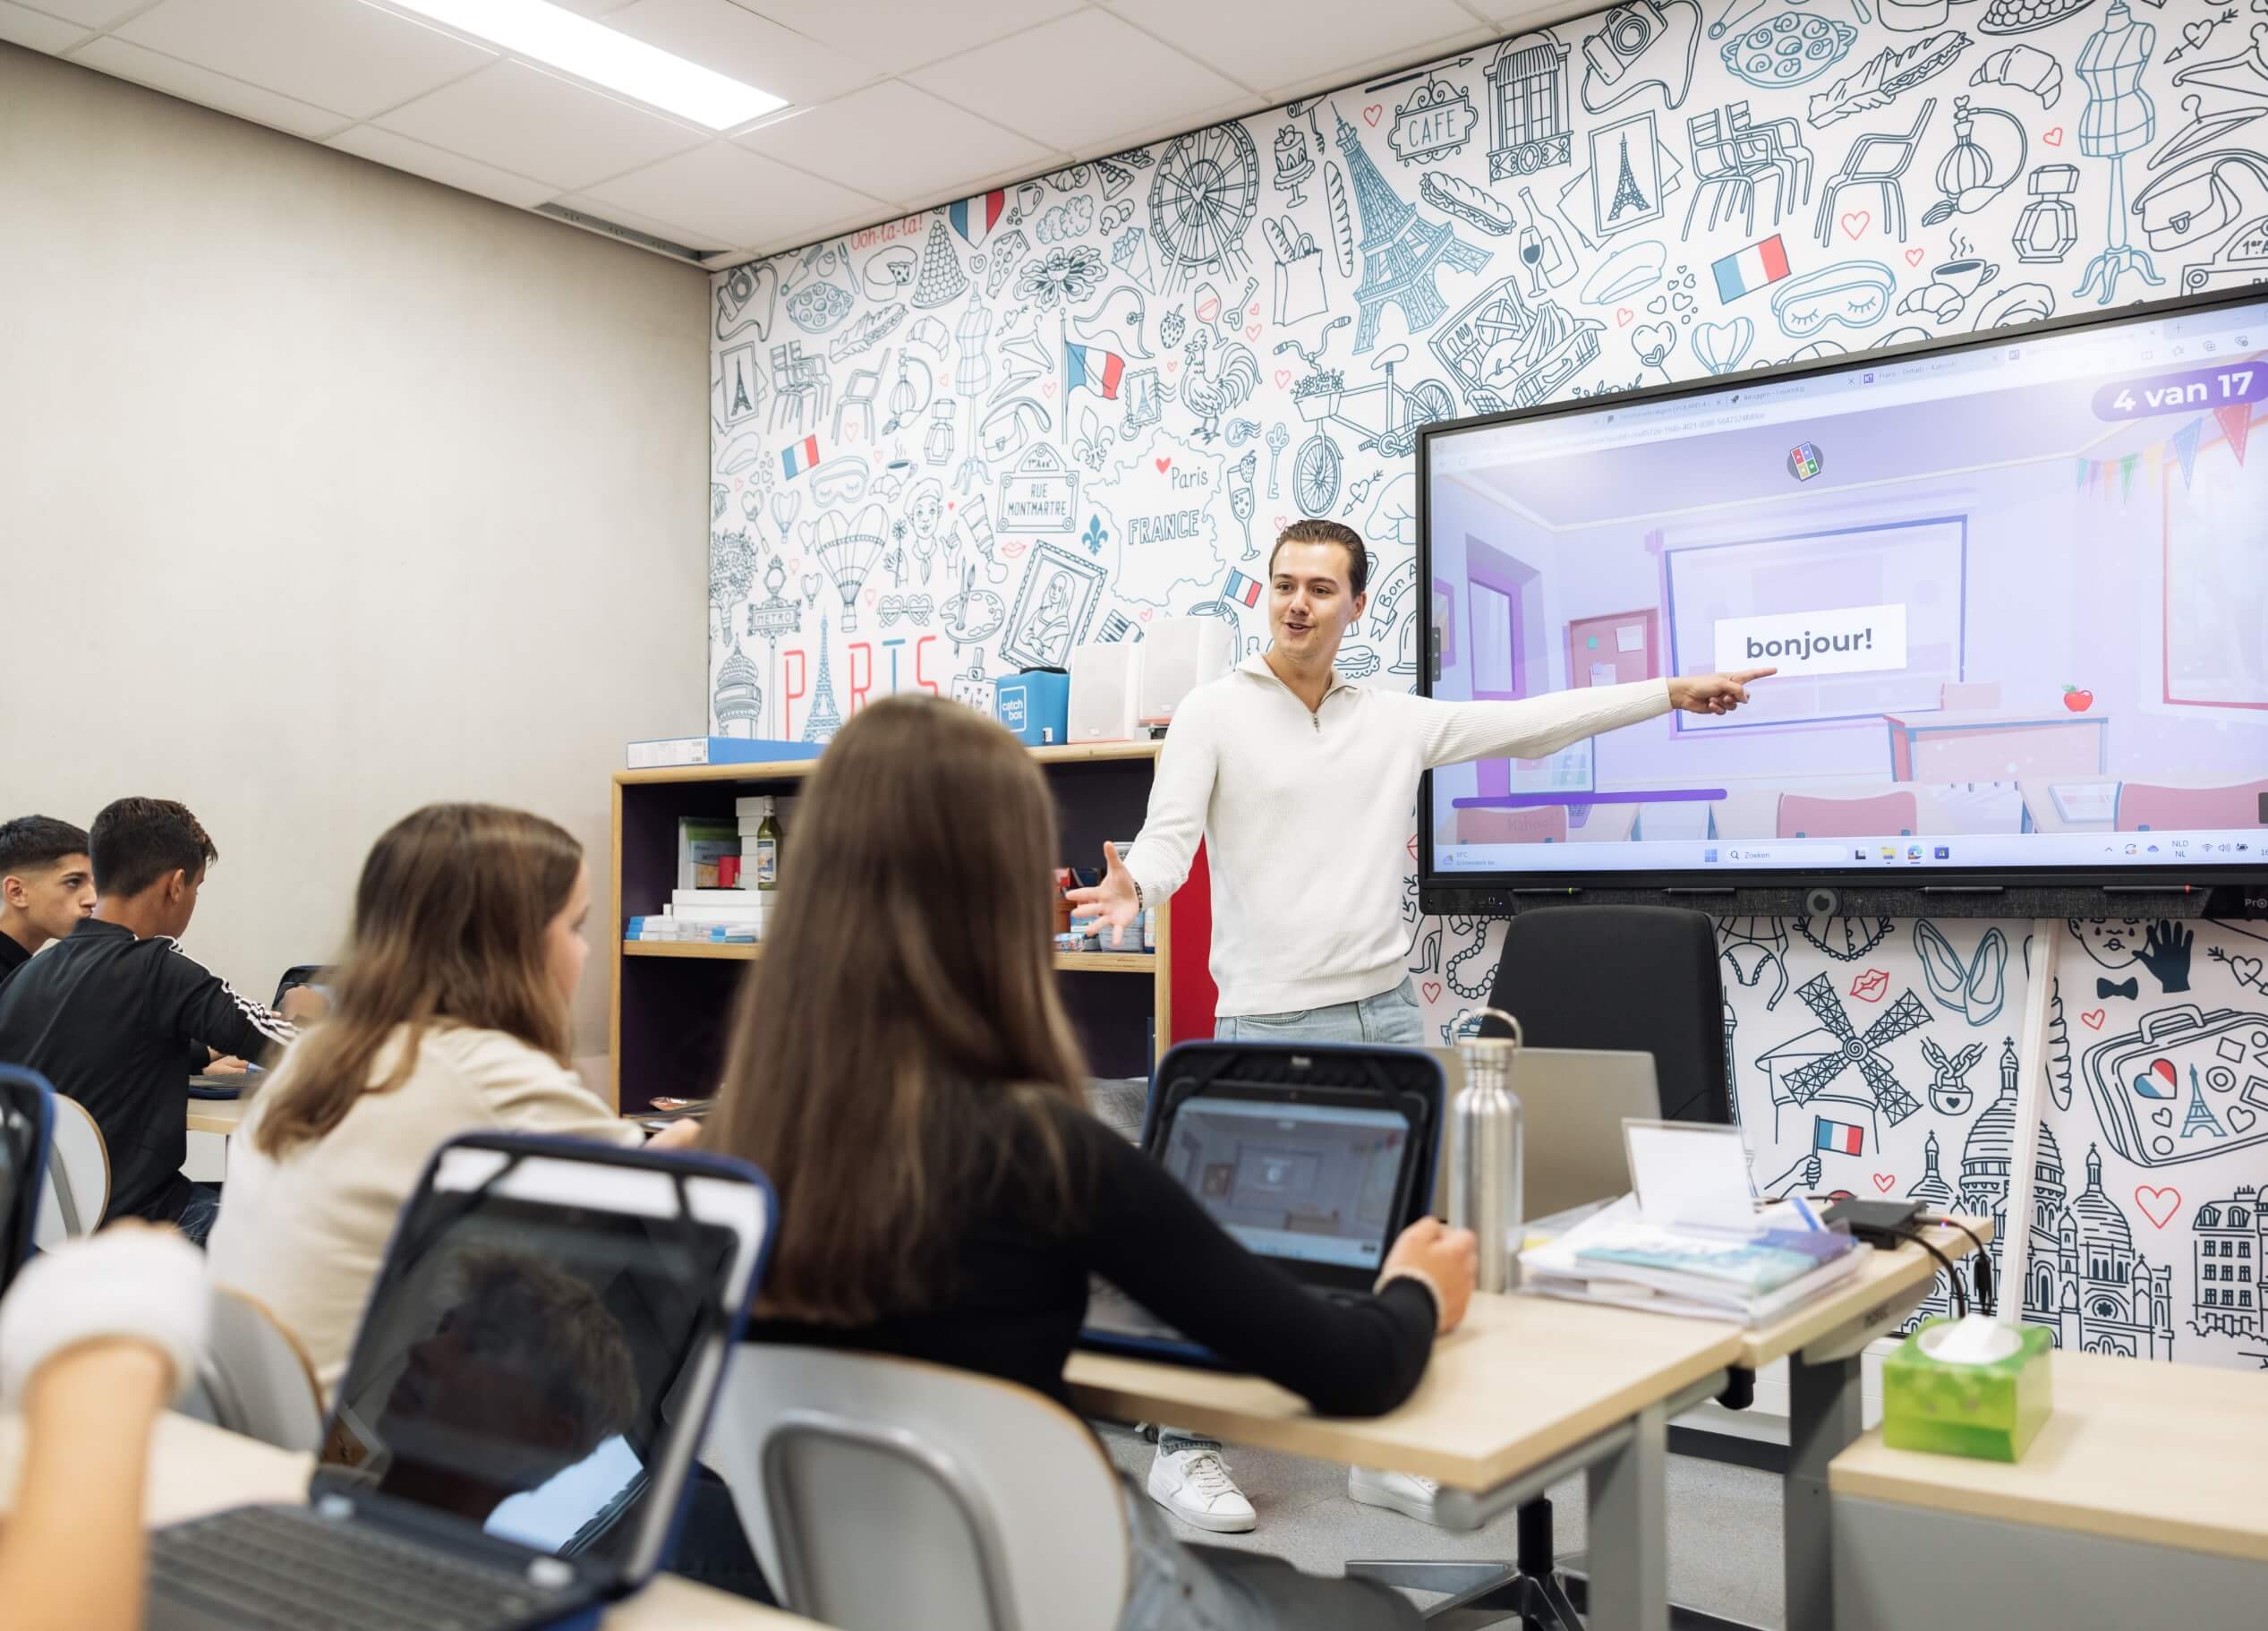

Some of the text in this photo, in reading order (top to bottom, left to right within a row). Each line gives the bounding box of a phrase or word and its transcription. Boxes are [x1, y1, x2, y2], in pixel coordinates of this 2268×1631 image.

[1410, 109, 1455, 147] CAFE
[2113, 371, 2254, 411] 4 van 17
[1172, 465, 1208, 491] Paris
[1031, 483, 1048, 498] RUE
[1008, 501, 1067, 516] MONTMARTRE
[1128, 508, 1199, 545] FRANCE
[1378, 578, 1405, 607] Bon
[756, 612, 791, 625] METRO
[1746, 628, 1872, 661] bonjour!
[1002, 698, 1024, 712] catch
[1009, 711, 1024, 721] box
[1744, 851, 1770, 859] Zoeken
